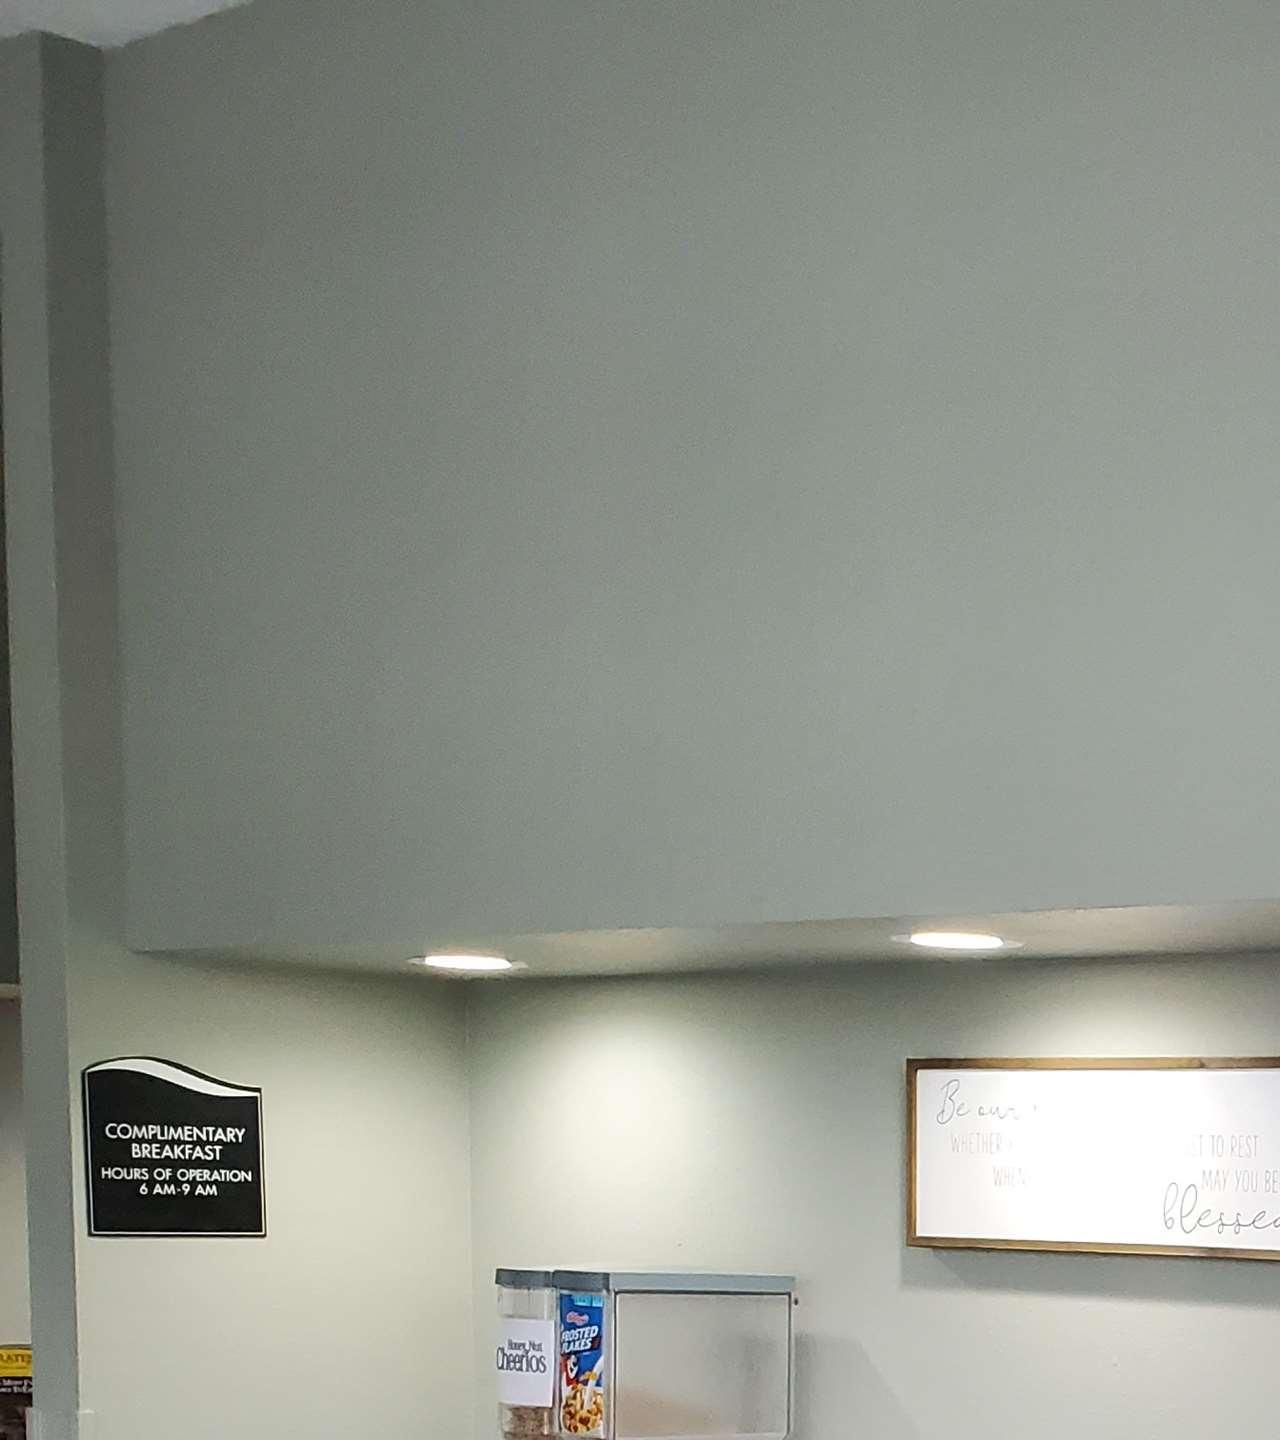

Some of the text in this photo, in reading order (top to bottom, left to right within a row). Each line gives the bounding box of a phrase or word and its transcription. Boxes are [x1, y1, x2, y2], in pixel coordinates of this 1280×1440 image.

[936, 1079, 971, 1125] Be
[105, 1123, 246, 1143] COMPLIMENTARY
[131, 1143, 223, 1161] BREAKFAST
[1210, 1134, 1224, 1158] TO
[1230, 1134, 1260, 1158] REST
[101, 1167, 252, 1182] HOURS OF OPERATION
[1202, 1169, 1279, 1193] MAY YOU BE
[139, 1183, 148, 1195] 6
[195, 1184, 218, 1196] AM
[529, 1340, 543, 1352] Nut
[496, 1346, 547, 1373] Cheerios
